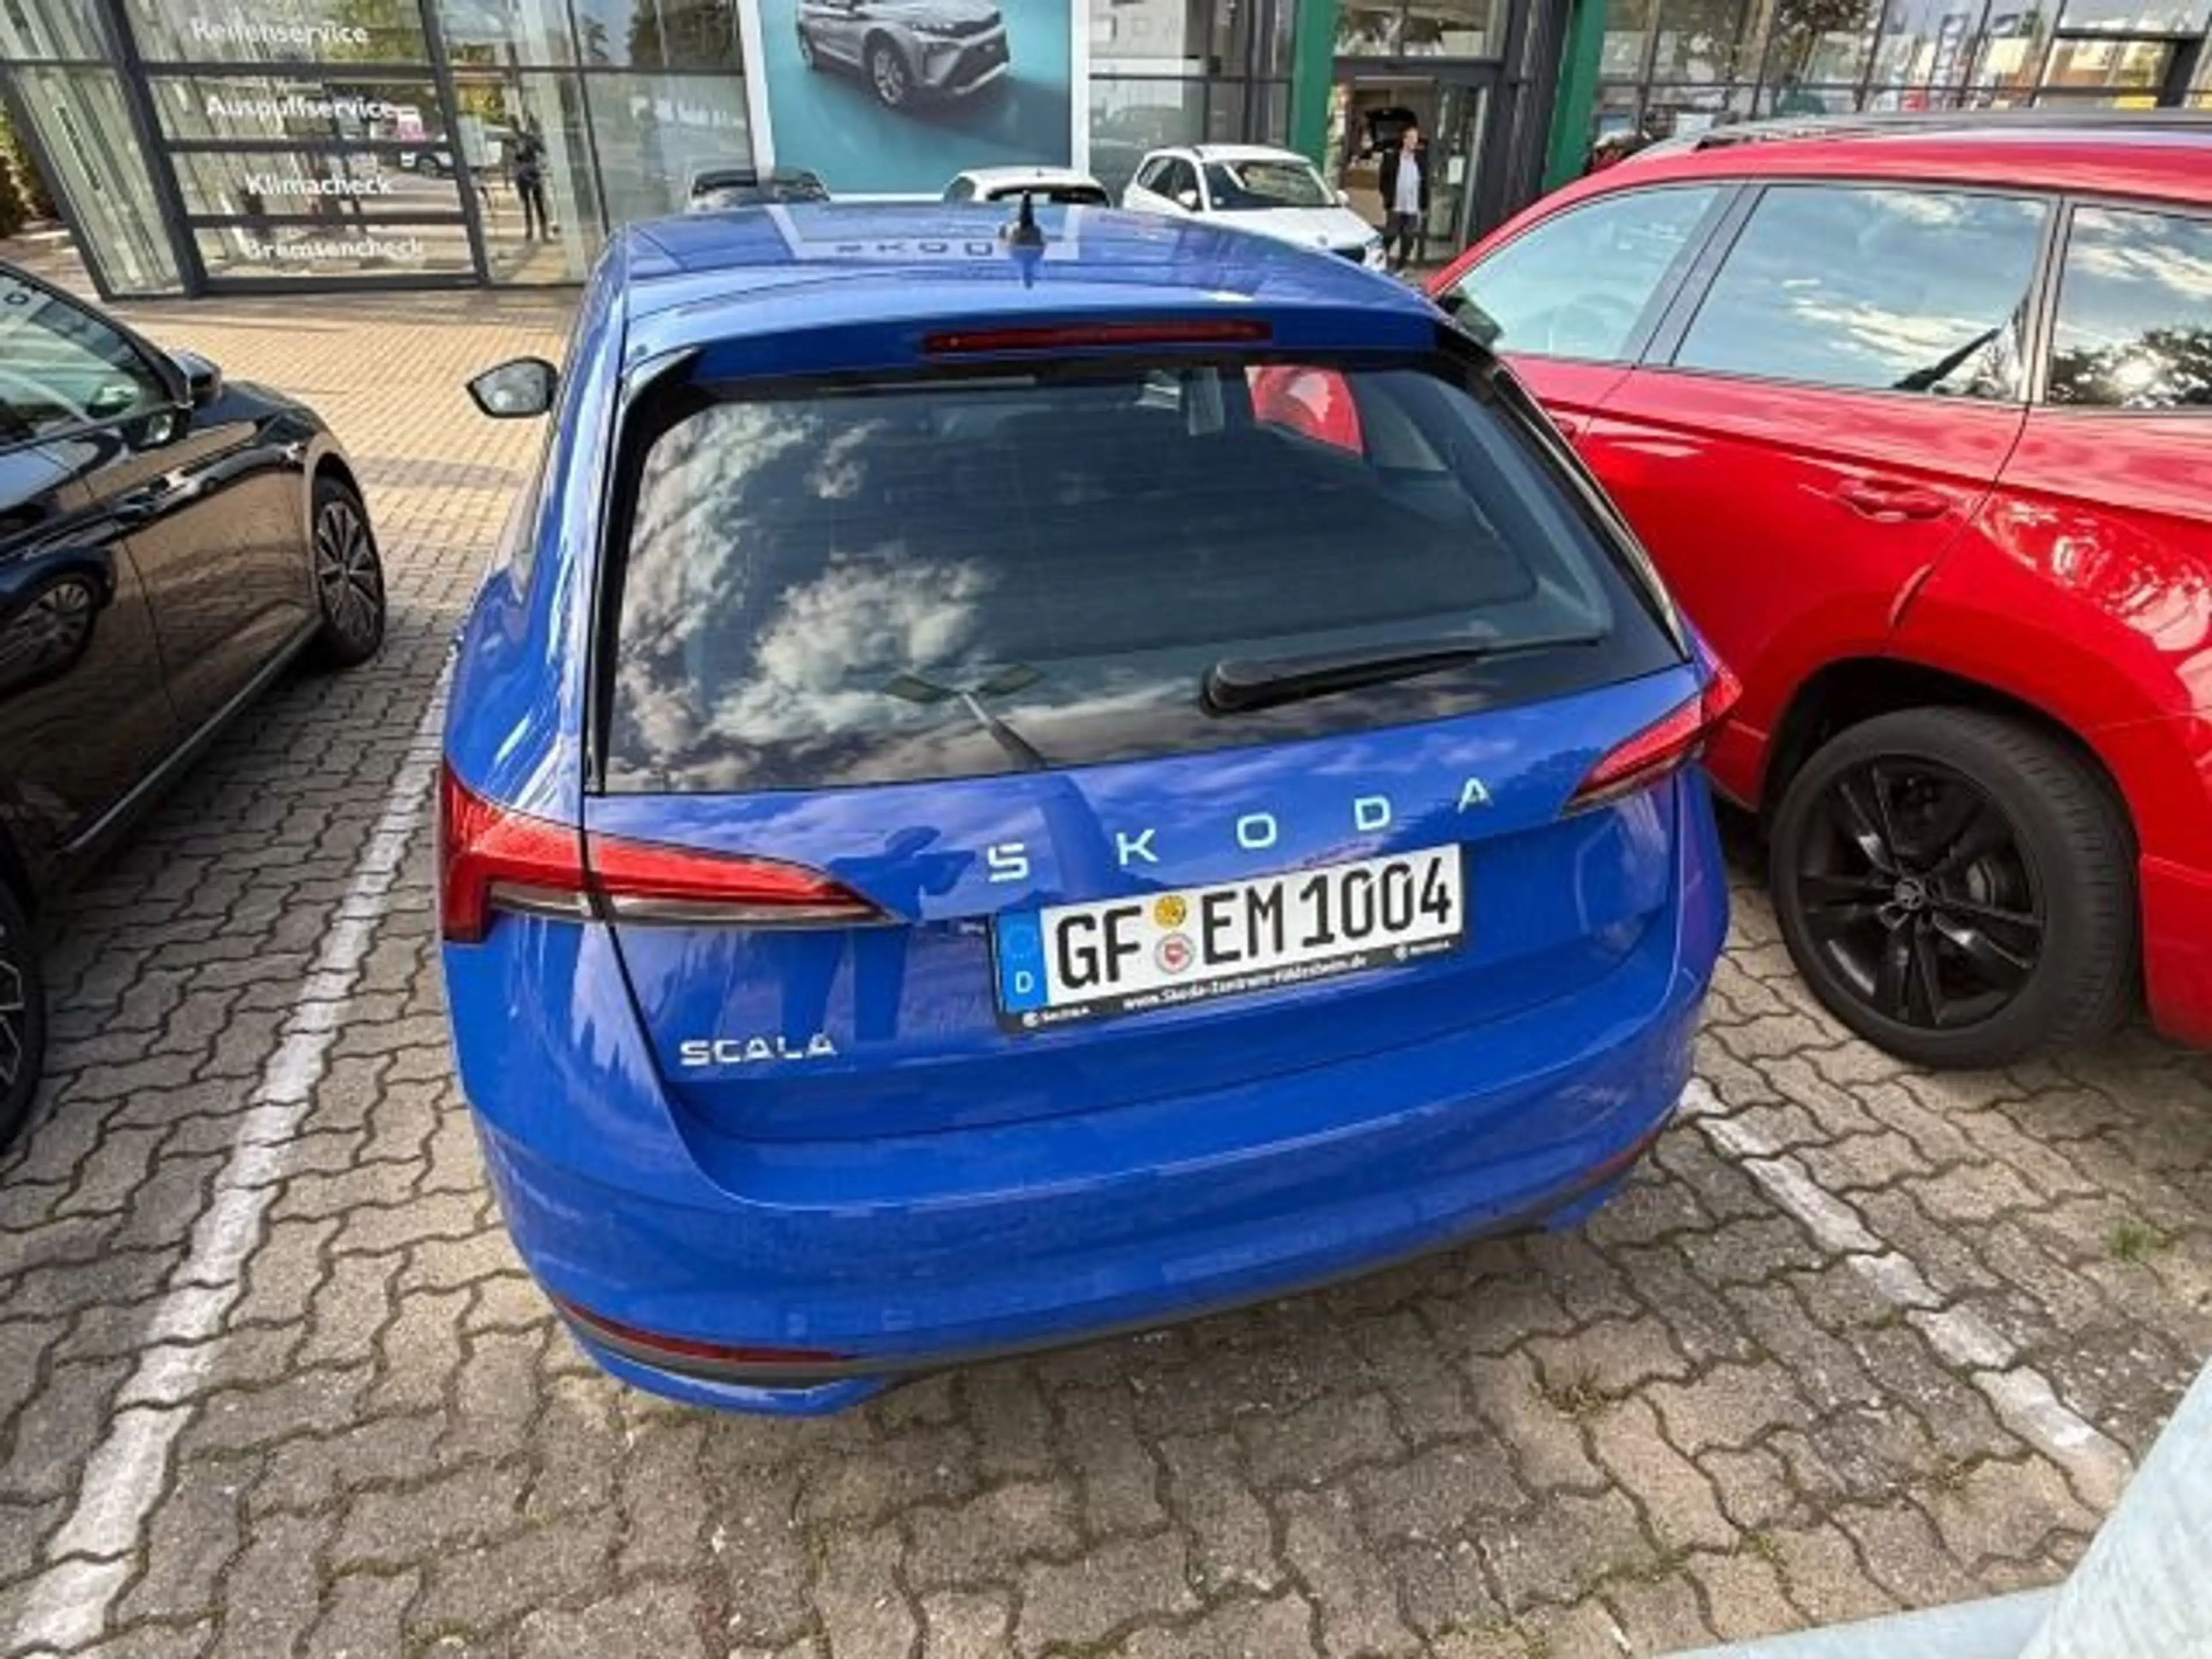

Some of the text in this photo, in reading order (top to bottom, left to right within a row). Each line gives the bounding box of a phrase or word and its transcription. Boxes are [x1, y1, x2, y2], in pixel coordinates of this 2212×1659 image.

[245, 172, 392, 195] Klimacheck
[987, 778, 1490, 881] SKODA
[1056, 906, 1142, 989] GF
[1301, 857, 1452, 948] 1004
[1015, 971, 1034, 993] D
[680, 1032, 838, 1066] SCALA
